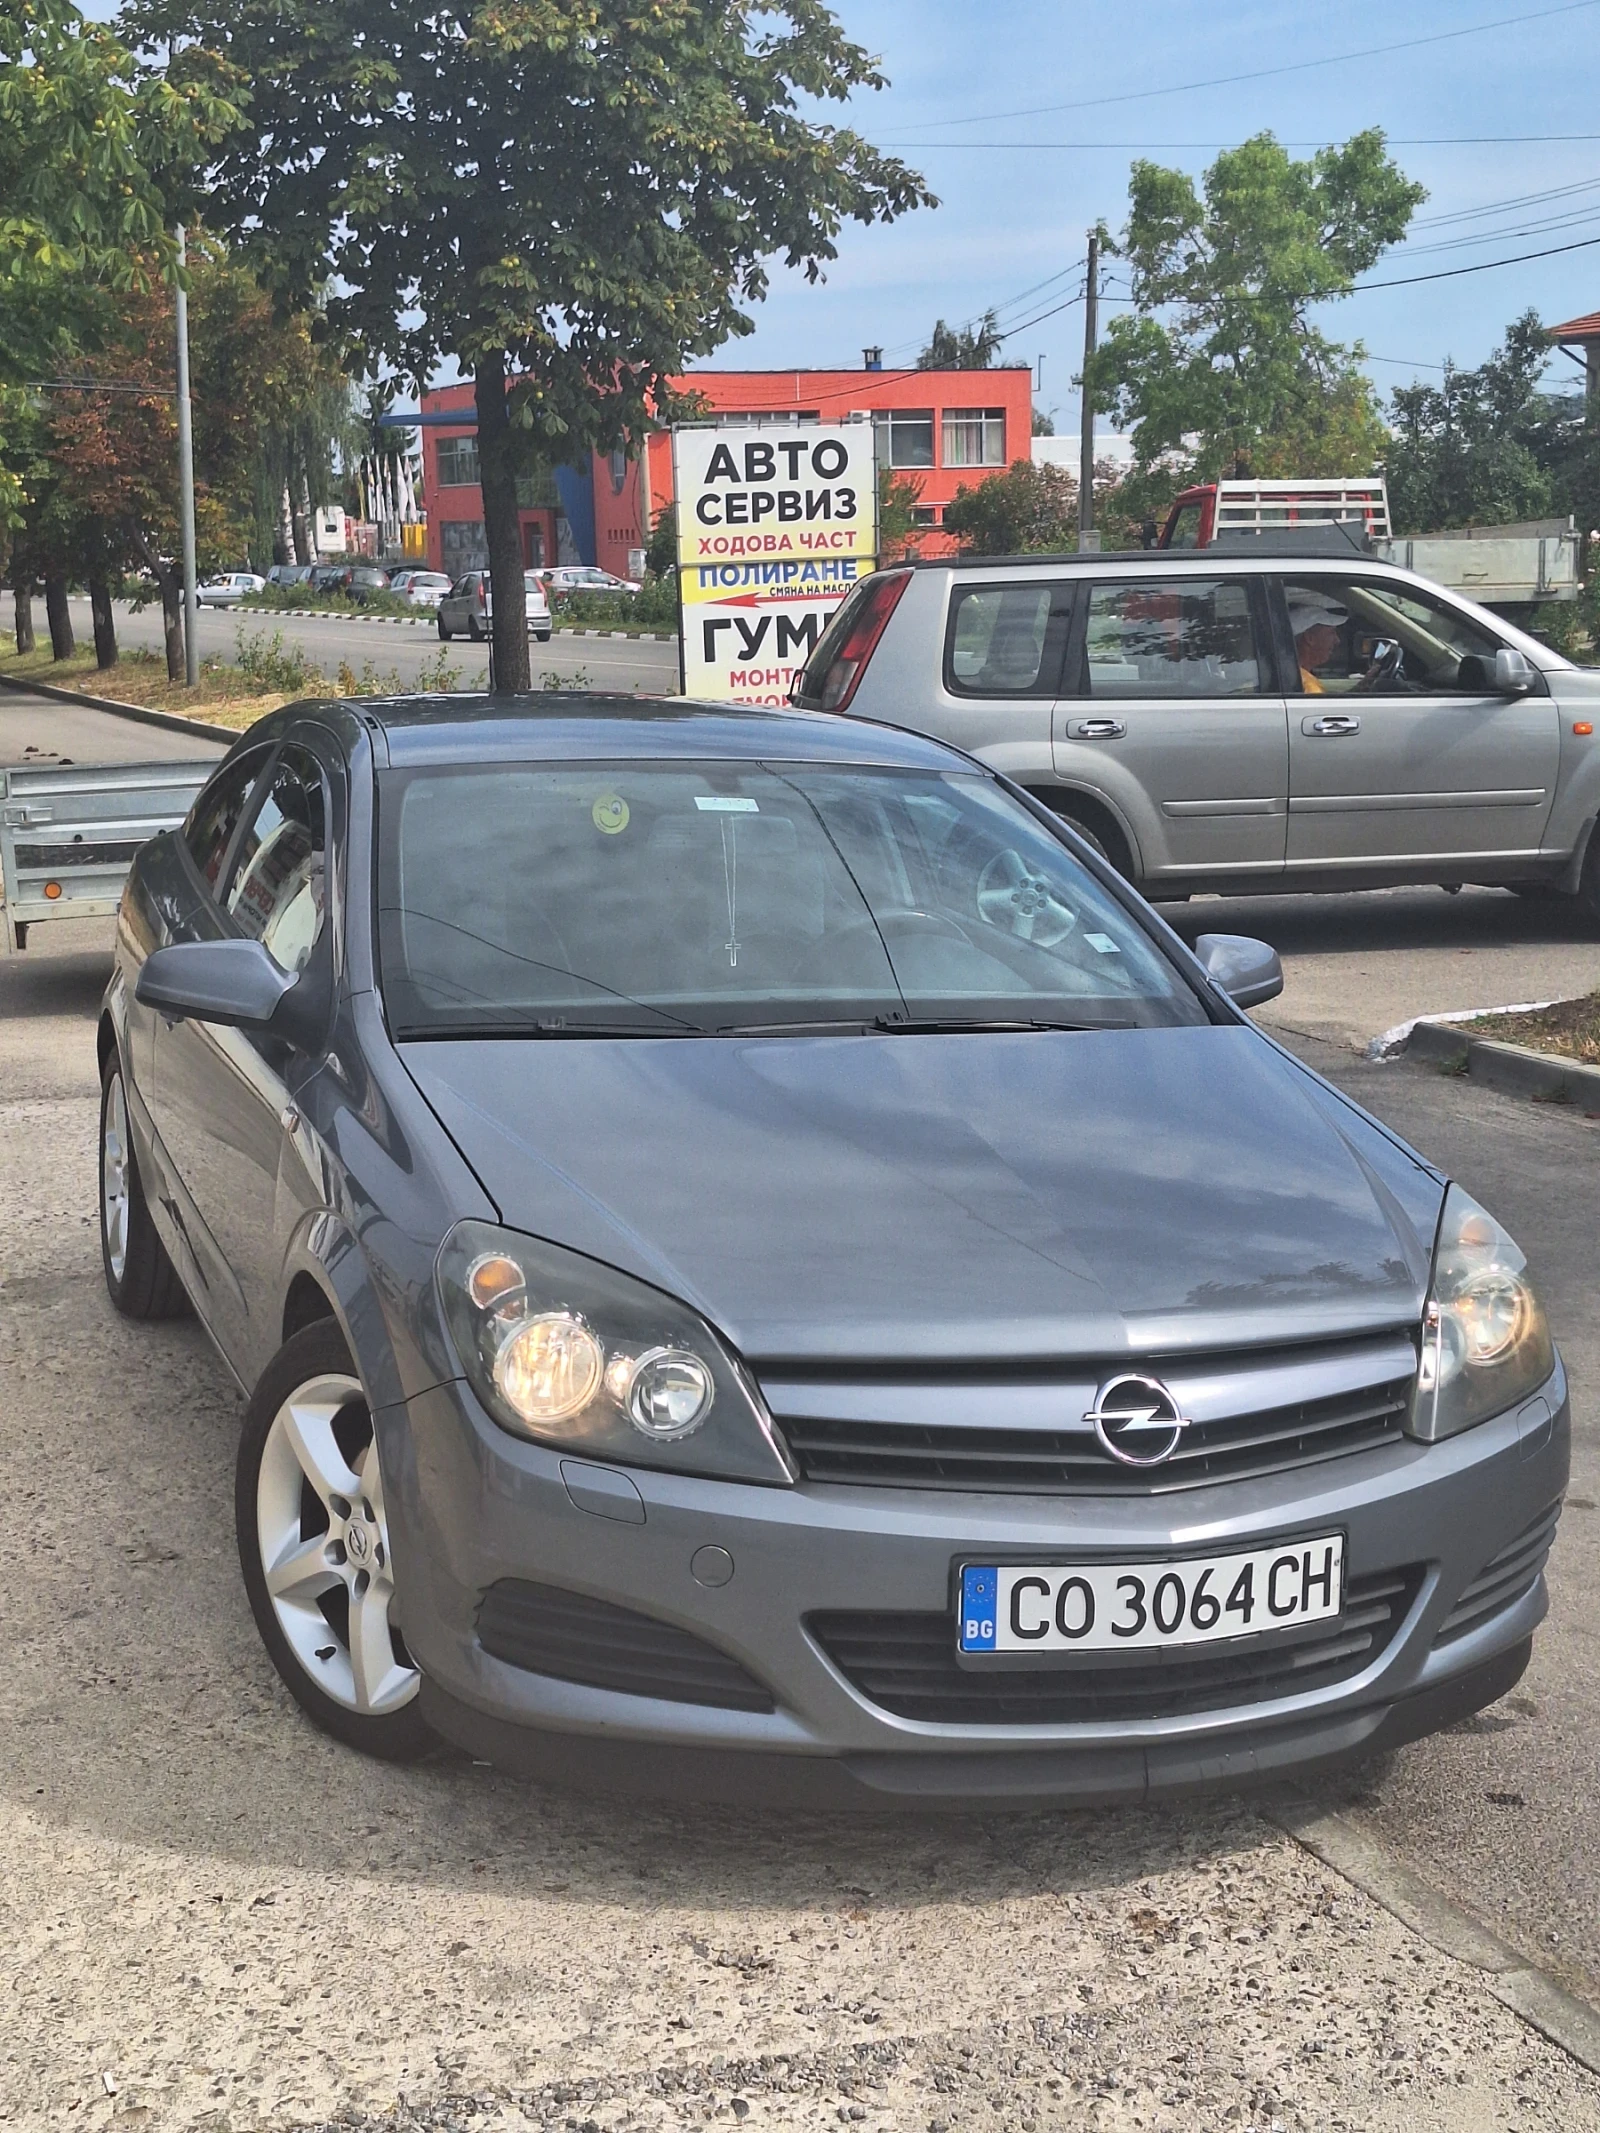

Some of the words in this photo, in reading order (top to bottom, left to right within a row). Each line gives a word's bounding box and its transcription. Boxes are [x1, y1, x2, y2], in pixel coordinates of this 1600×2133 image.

[703, 439, 849, 484] АВТО
[696, 487, 858, 526] СЕРВИЗ
[698, 534, 794, 556] ХОДОВА
[799, 531, 858, 550] ЧАСТ
[699, 559, 858, 588] ПОЛИРАНЕ
[770, 585, 804, 596] СМЯНА
[807, 585, 821, 595] НА
[823, 582, 856, 594] МАСЛ
[703, 612, 834, 663] ГУМ
[730, 667, 800, 688] МОНТ
[1010, 1575, 1095, 1639] CO
[1111, 1562, 1255, 1638] 3064
[1268, 1546, 1333, 1618] CH
[965, 1619, 993, 1640] BG
